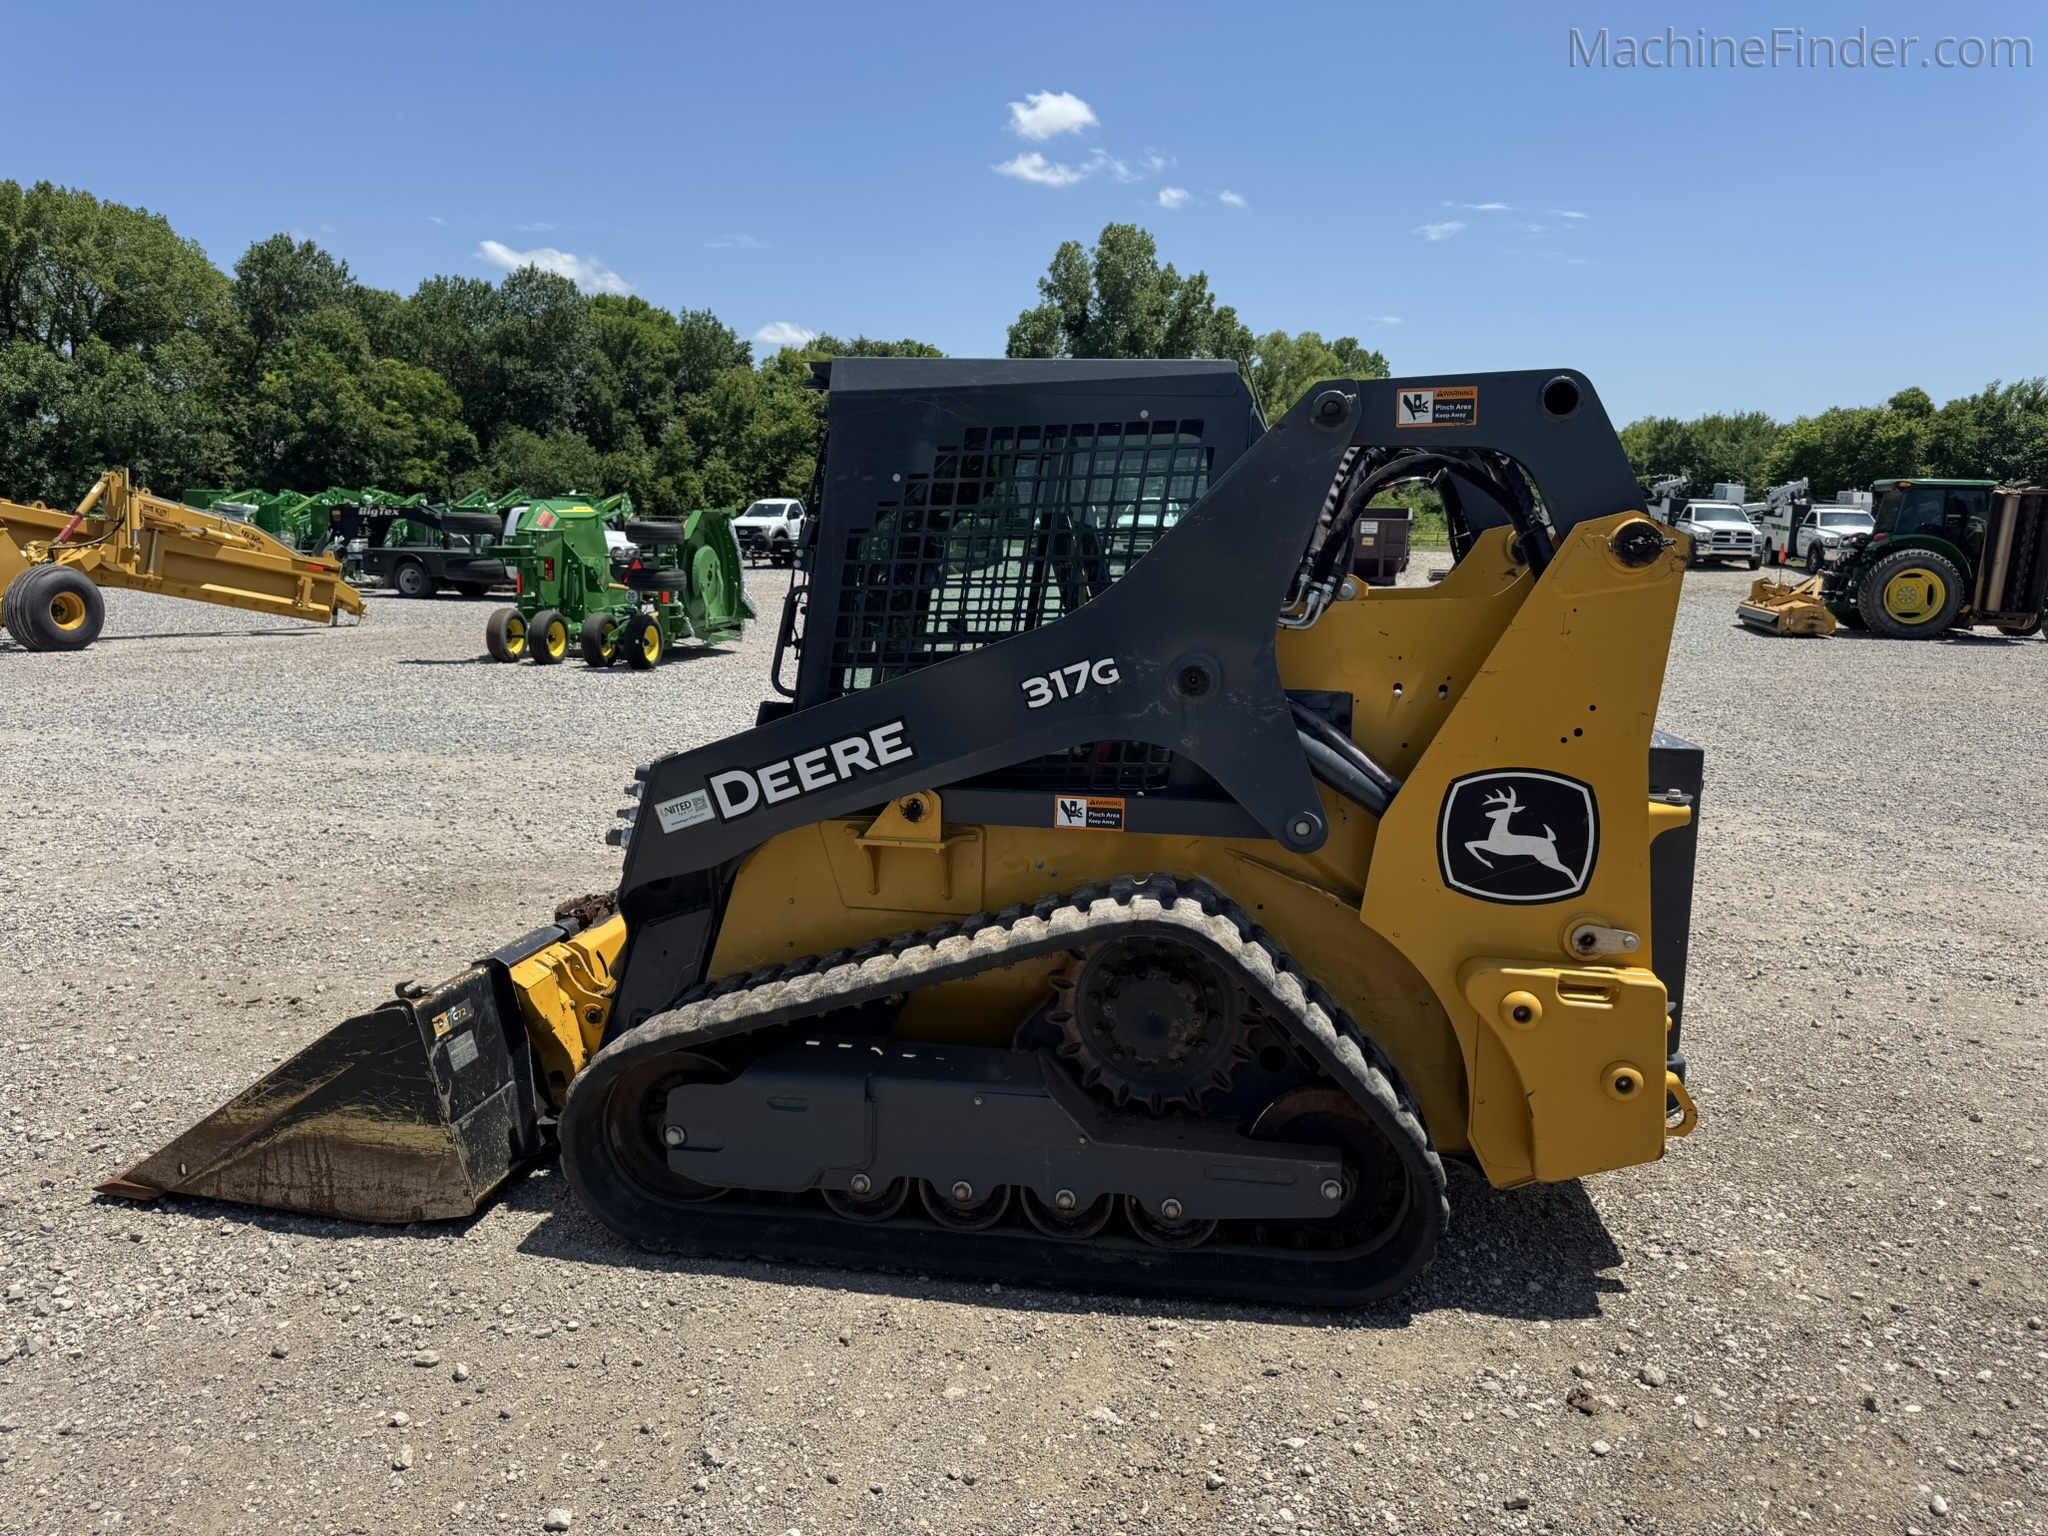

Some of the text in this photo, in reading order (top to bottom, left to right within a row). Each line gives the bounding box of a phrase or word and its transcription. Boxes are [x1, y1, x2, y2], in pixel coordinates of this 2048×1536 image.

[1021, 657, 1120, 708] 317G
[709, 721, 913, 819] DEERE
[659, 800, 692, 817] UNITED
[452, 1008, 467, 1020] C72
